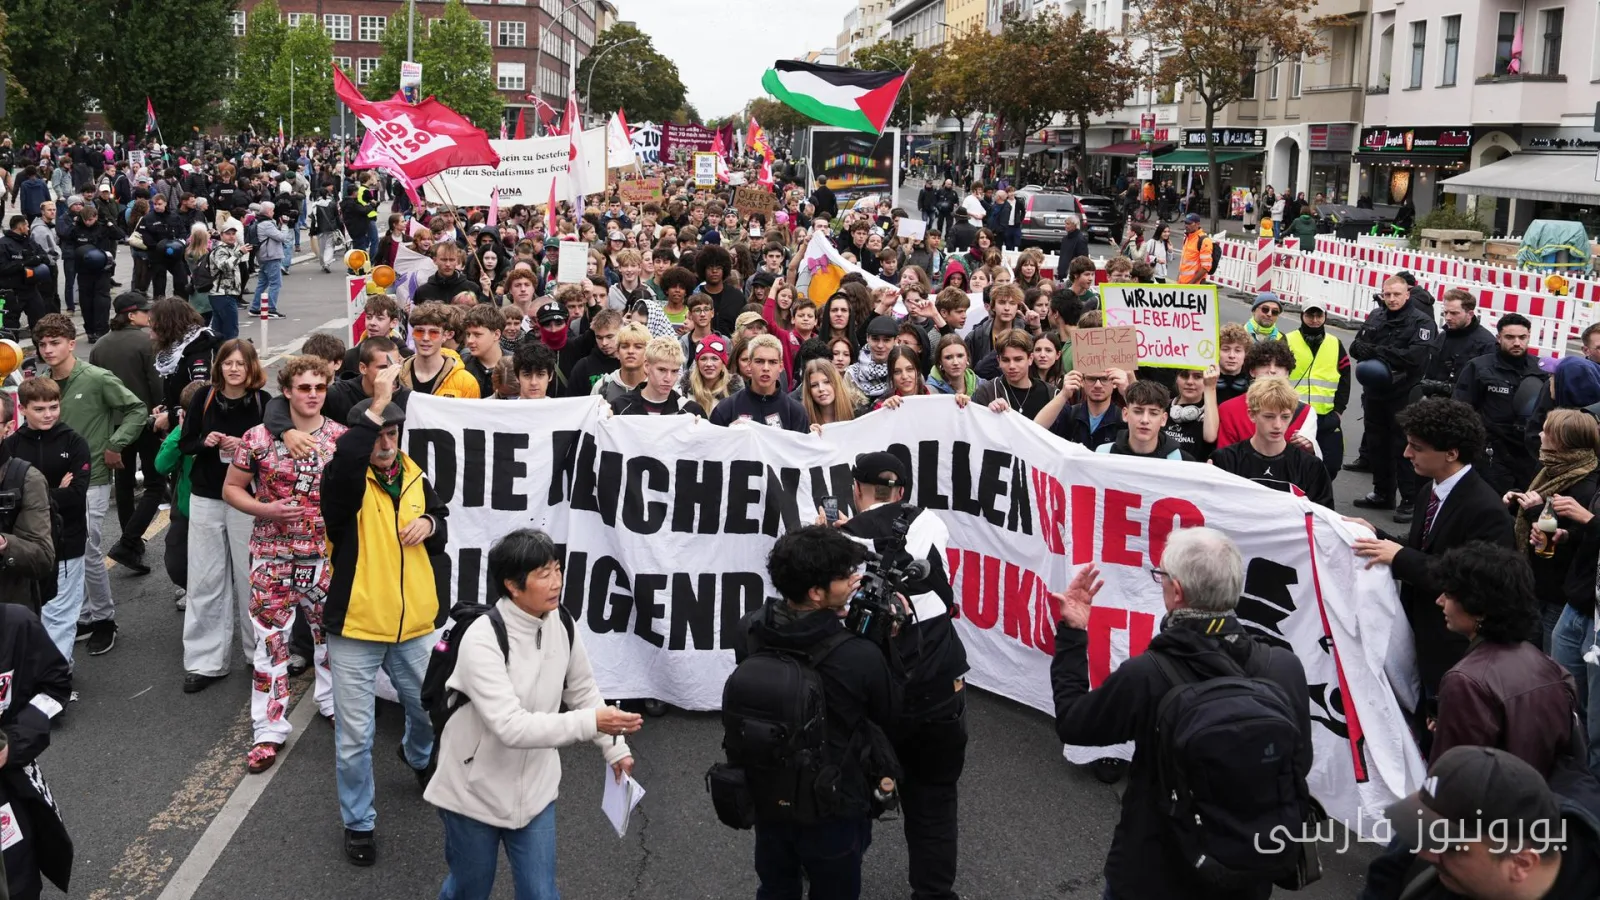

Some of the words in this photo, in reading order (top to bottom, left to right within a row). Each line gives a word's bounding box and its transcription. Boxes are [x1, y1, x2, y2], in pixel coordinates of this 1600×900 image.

[643, 131, 659, 147] ZU
[481, 166, 534, 176] Sozialismus
[739, 189, 770, 203] QUEERS
[1122, 288, 1149, 308] WIR
[1150, 291, 1207, 314] WOLLEN
[1132, 309, 1204, 331] LEBENDE
[1075, 328, 1132, 346] MERZ
[1136, 330, 1189, 358] Brüder
[1110, 348, 1136, 364] selber
[1488, 385, 1509, 394] POLIZEI
[408, 428, 529, 511] DIE
[548, 430, 801, 538] REICHEN
